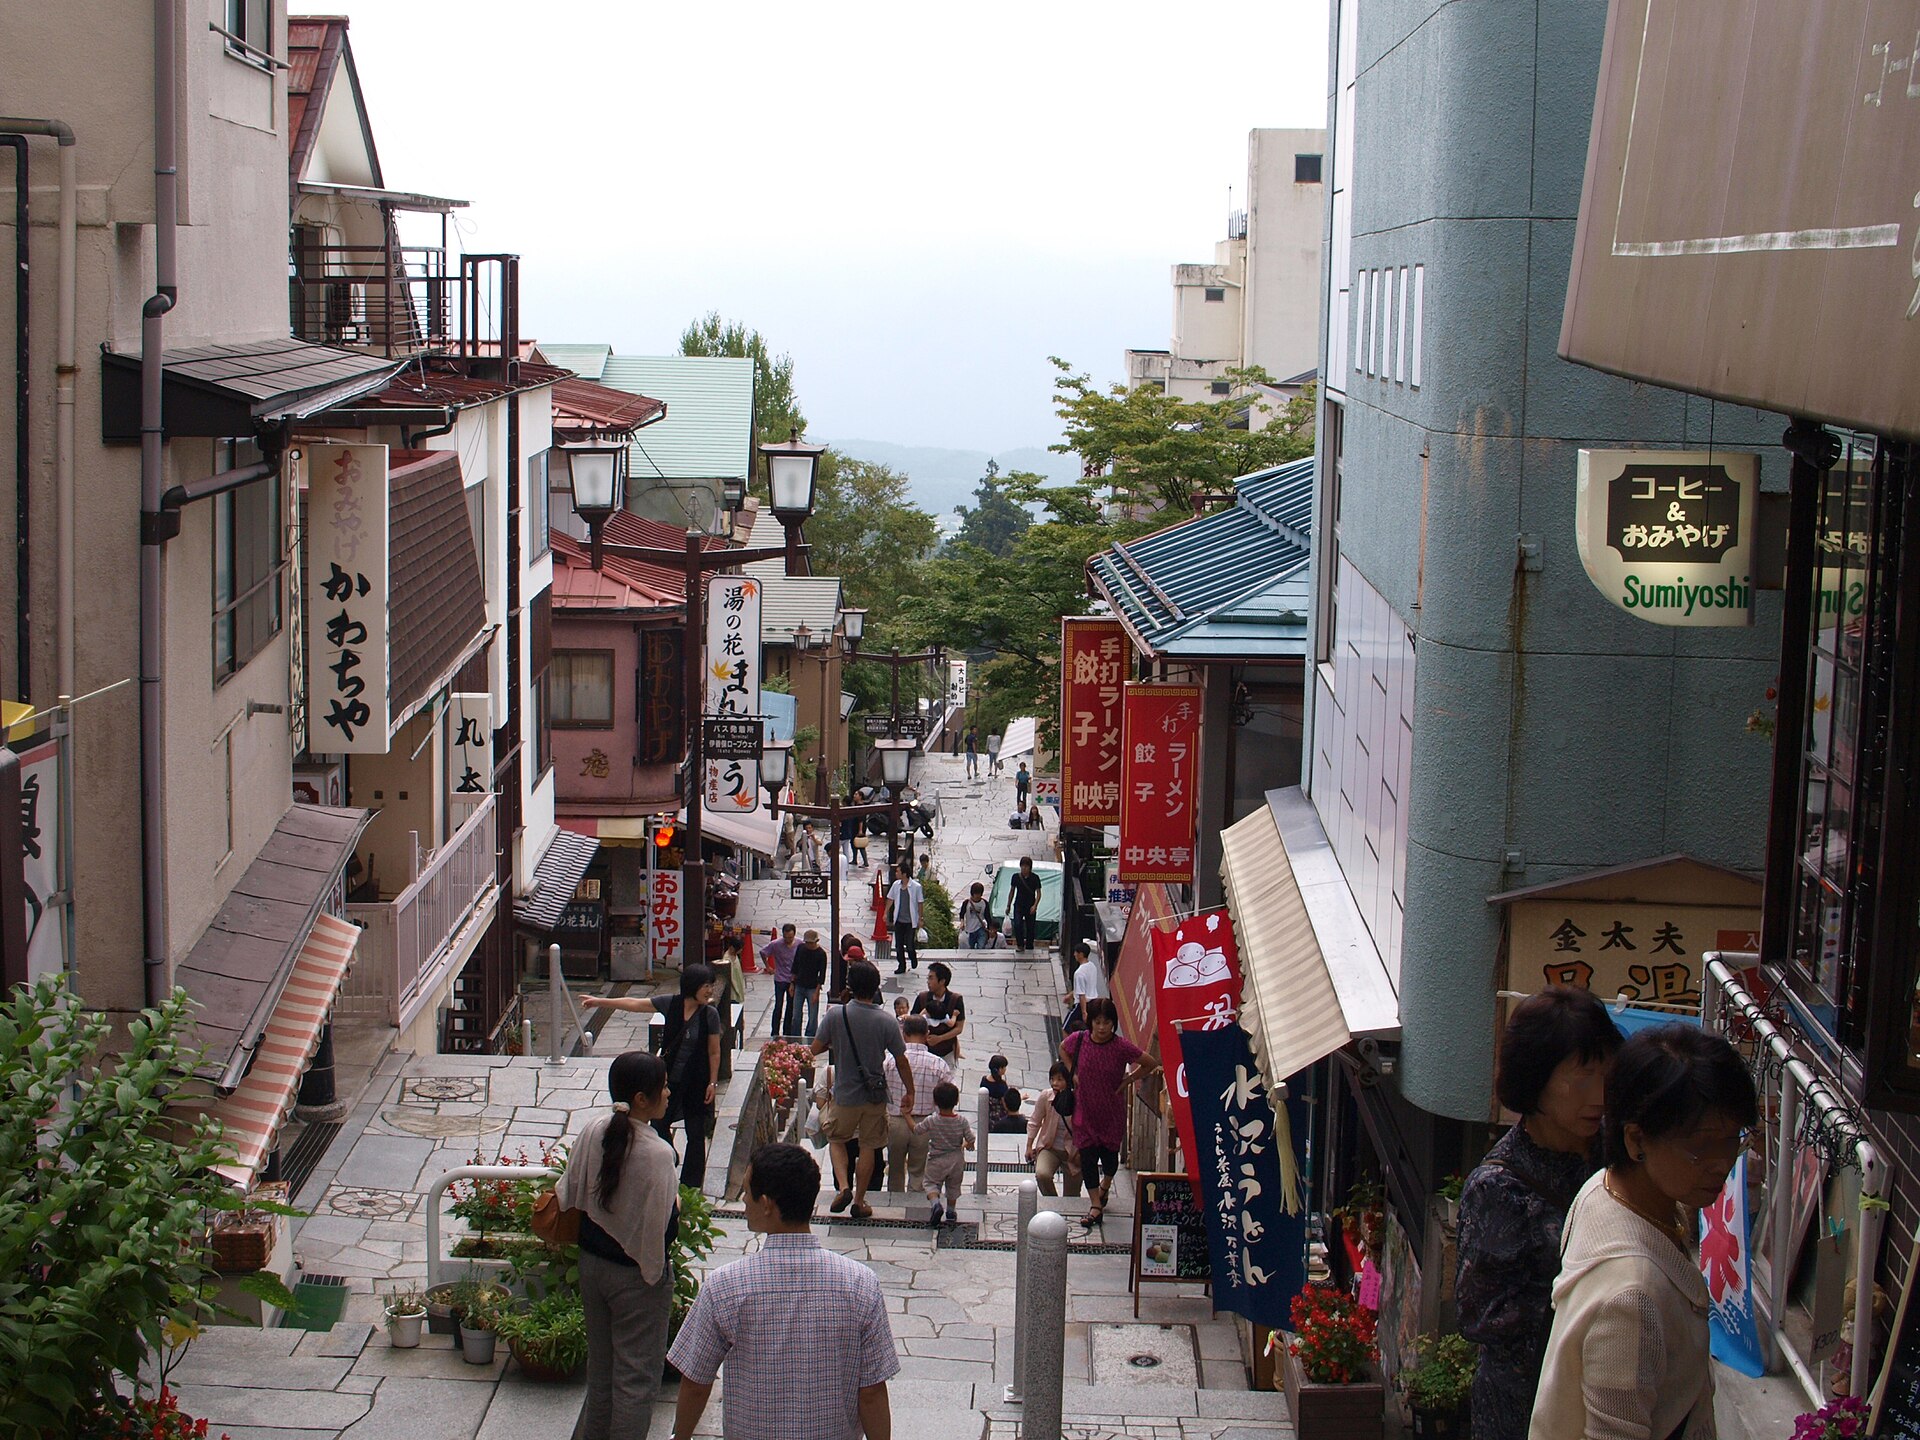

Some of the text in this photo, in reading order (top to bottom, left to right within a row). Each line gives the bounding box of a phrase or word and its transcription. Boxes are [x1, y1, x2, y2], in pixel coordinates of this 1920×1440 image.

[332, 450, 368, 562] おみやげ
[1632, 476, 1722, 499] コーヒー
[1667, 502, 1685, 521] &
[1622, 524, 1730, 548] おみやげ
[1622, 575, 1750, 616] Sumiyoshi
[320, 562, 371, 742] かわちや
[719, 586, 748, 797] 湯の花まんう
[1072, 650, 1099, 748] 餃子
[1098, 637, 1120, 772] 手打ラーメン
[713, 725, 754, 734] バス発着所
[708, 759, 718, 803] 物産店
[1134, 743, 1156, 803] 餃子
[1162, 702, 1194, 818] 手打 ラーメン
[1124, 846, 1190, 867] 中央亭
[652, 872, 680, 960] おみやげ
[1549, 918, 1686, 956] 金太夫
[1220, 1064, 1277, 1287] 水沢うどん
